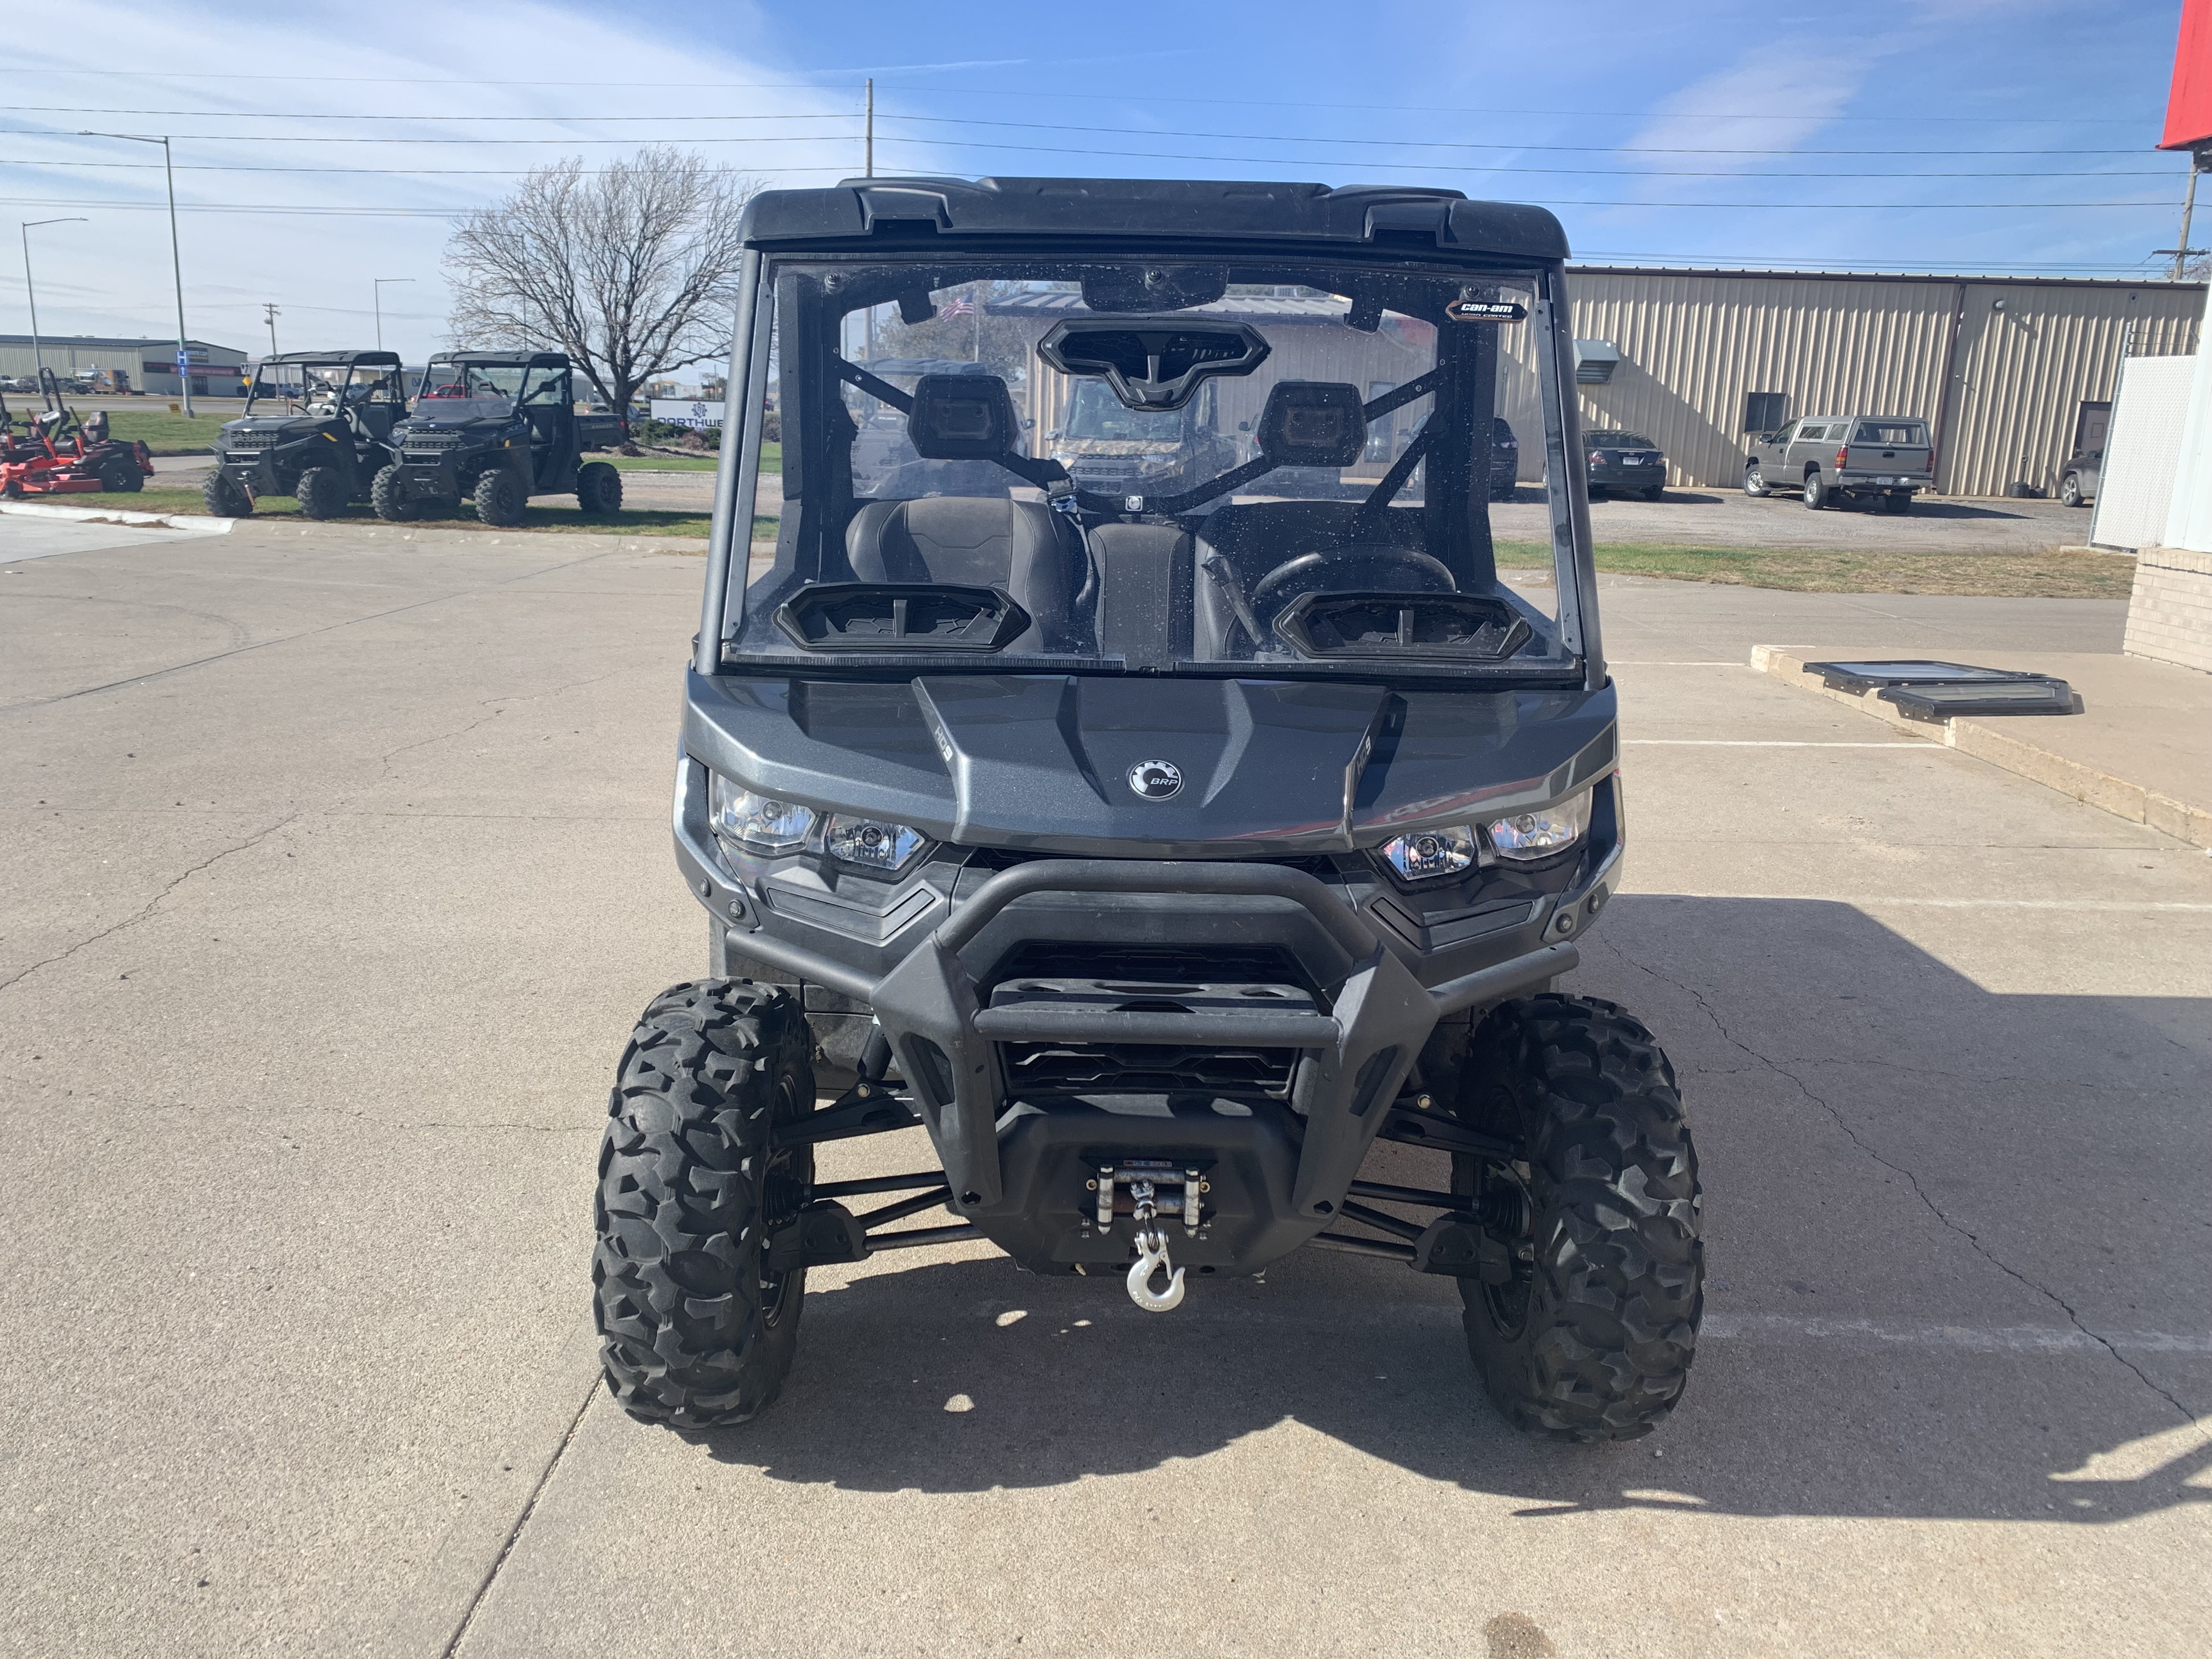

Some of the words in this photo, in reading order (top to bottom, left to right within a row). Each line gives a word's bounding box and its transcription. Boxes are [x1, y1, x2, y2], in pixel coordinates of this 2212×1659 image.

[1461, 303, 1513, 313] can-am
[177, 351, 187, 364] H
[935, 725, 953, 762] HD9
[1356, 735, 1371, 776] HD9
